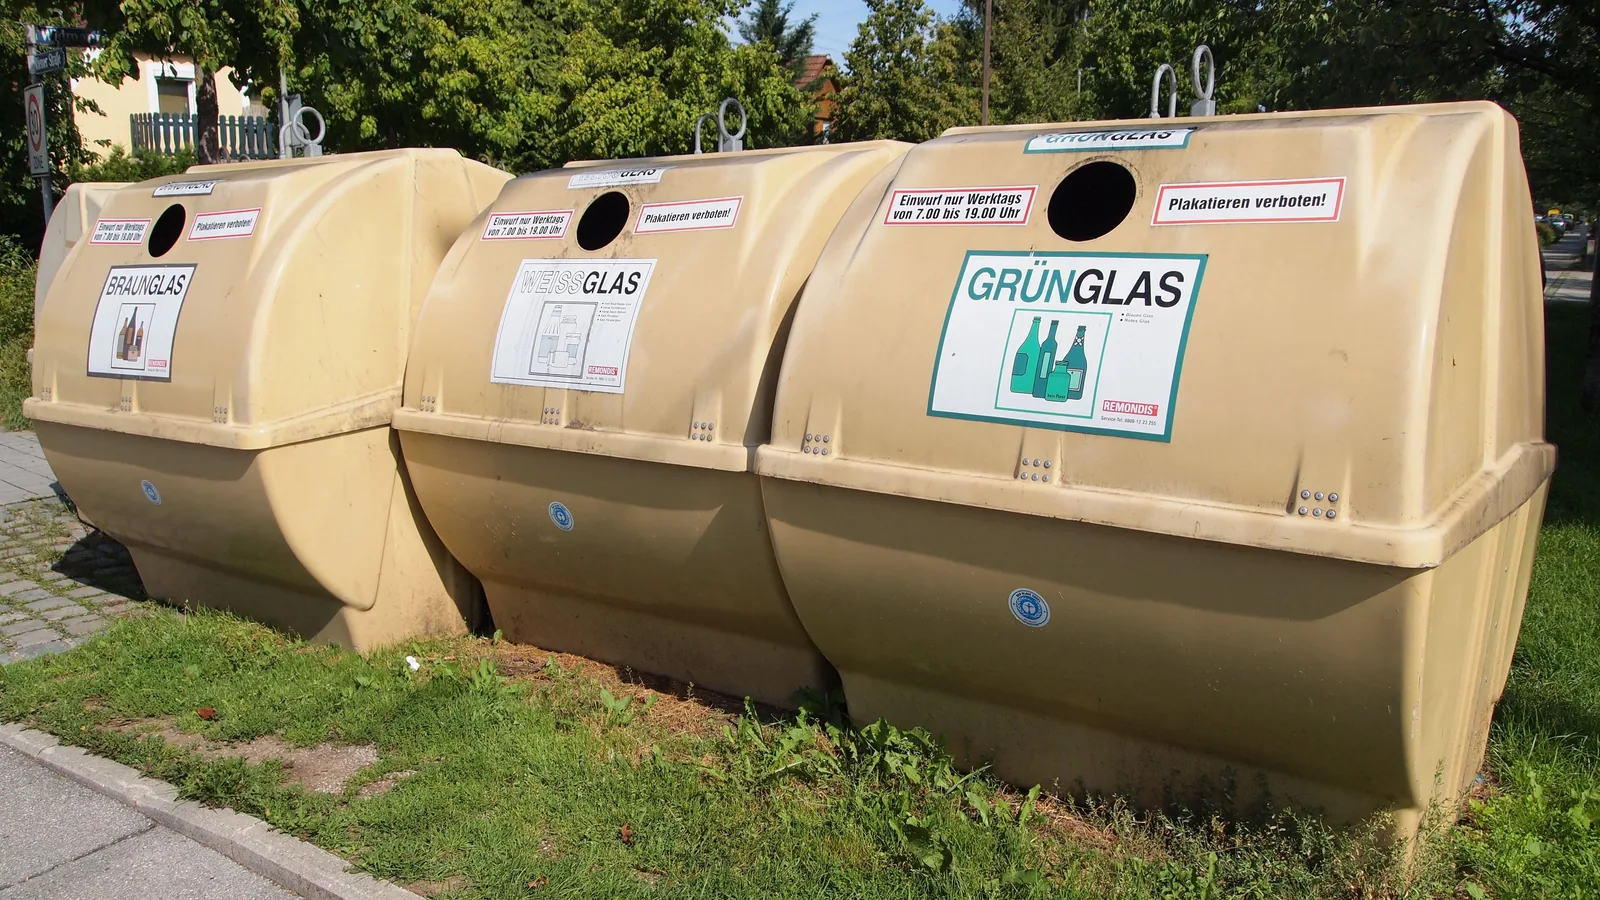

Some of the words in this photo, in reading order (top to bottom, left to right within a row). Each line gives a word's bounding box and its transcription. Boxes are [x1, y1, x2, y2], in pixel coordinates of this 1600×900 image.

[30, 109, 39, 136] 30
[899, 194, 943, 206] Einwurf
[944, 195, 965, 206] nur
[967, 193, 1023, 206] Werktags
[1168, 196, 1250, 211] Plakatieren
[1255, 193, 1328, 209] verboten!
[493, 216, 519, 226] Einwurf
[519, 217, 532, 225] nur
[532, 215, 565, 225] Werktags
[644, 210, 690, 224] Plakatieren
[692, 207, 731, 220] verboten!
[893, 209, 913, 220] von
[915, 208, 941, 220] 7.00
[943, 207, 960, 219] bis
[964, 206, 997, 219] 19.00
[998, 206, 1021, 219] Uhr
[98, 222, 115, 231] Einwurf
[115, 223, 124, 231] nur
[124, 222, 146, 232] Werktags
[195, 221, 226, 232] Plakatieren
[226, 217, 253, 229] verboten!
[488, 228, 500, 236] von
[500, 226, 517, 236] 7.00
[517, 226, 528, 236] bis
[529, 225, 549, 235] 19.00
[549, 225, 563, 234] Uhr
[93, 232, 103, 241] von
[113, 232, 121, 241] bis
[133, 232, 143, 241] Uhr
[105, 274, 186, 296] BRAUNGLAS
[520, 270, 642, 295] WEISSGLAS
[967, 259, 1185, 308] GRÜNGLAS
